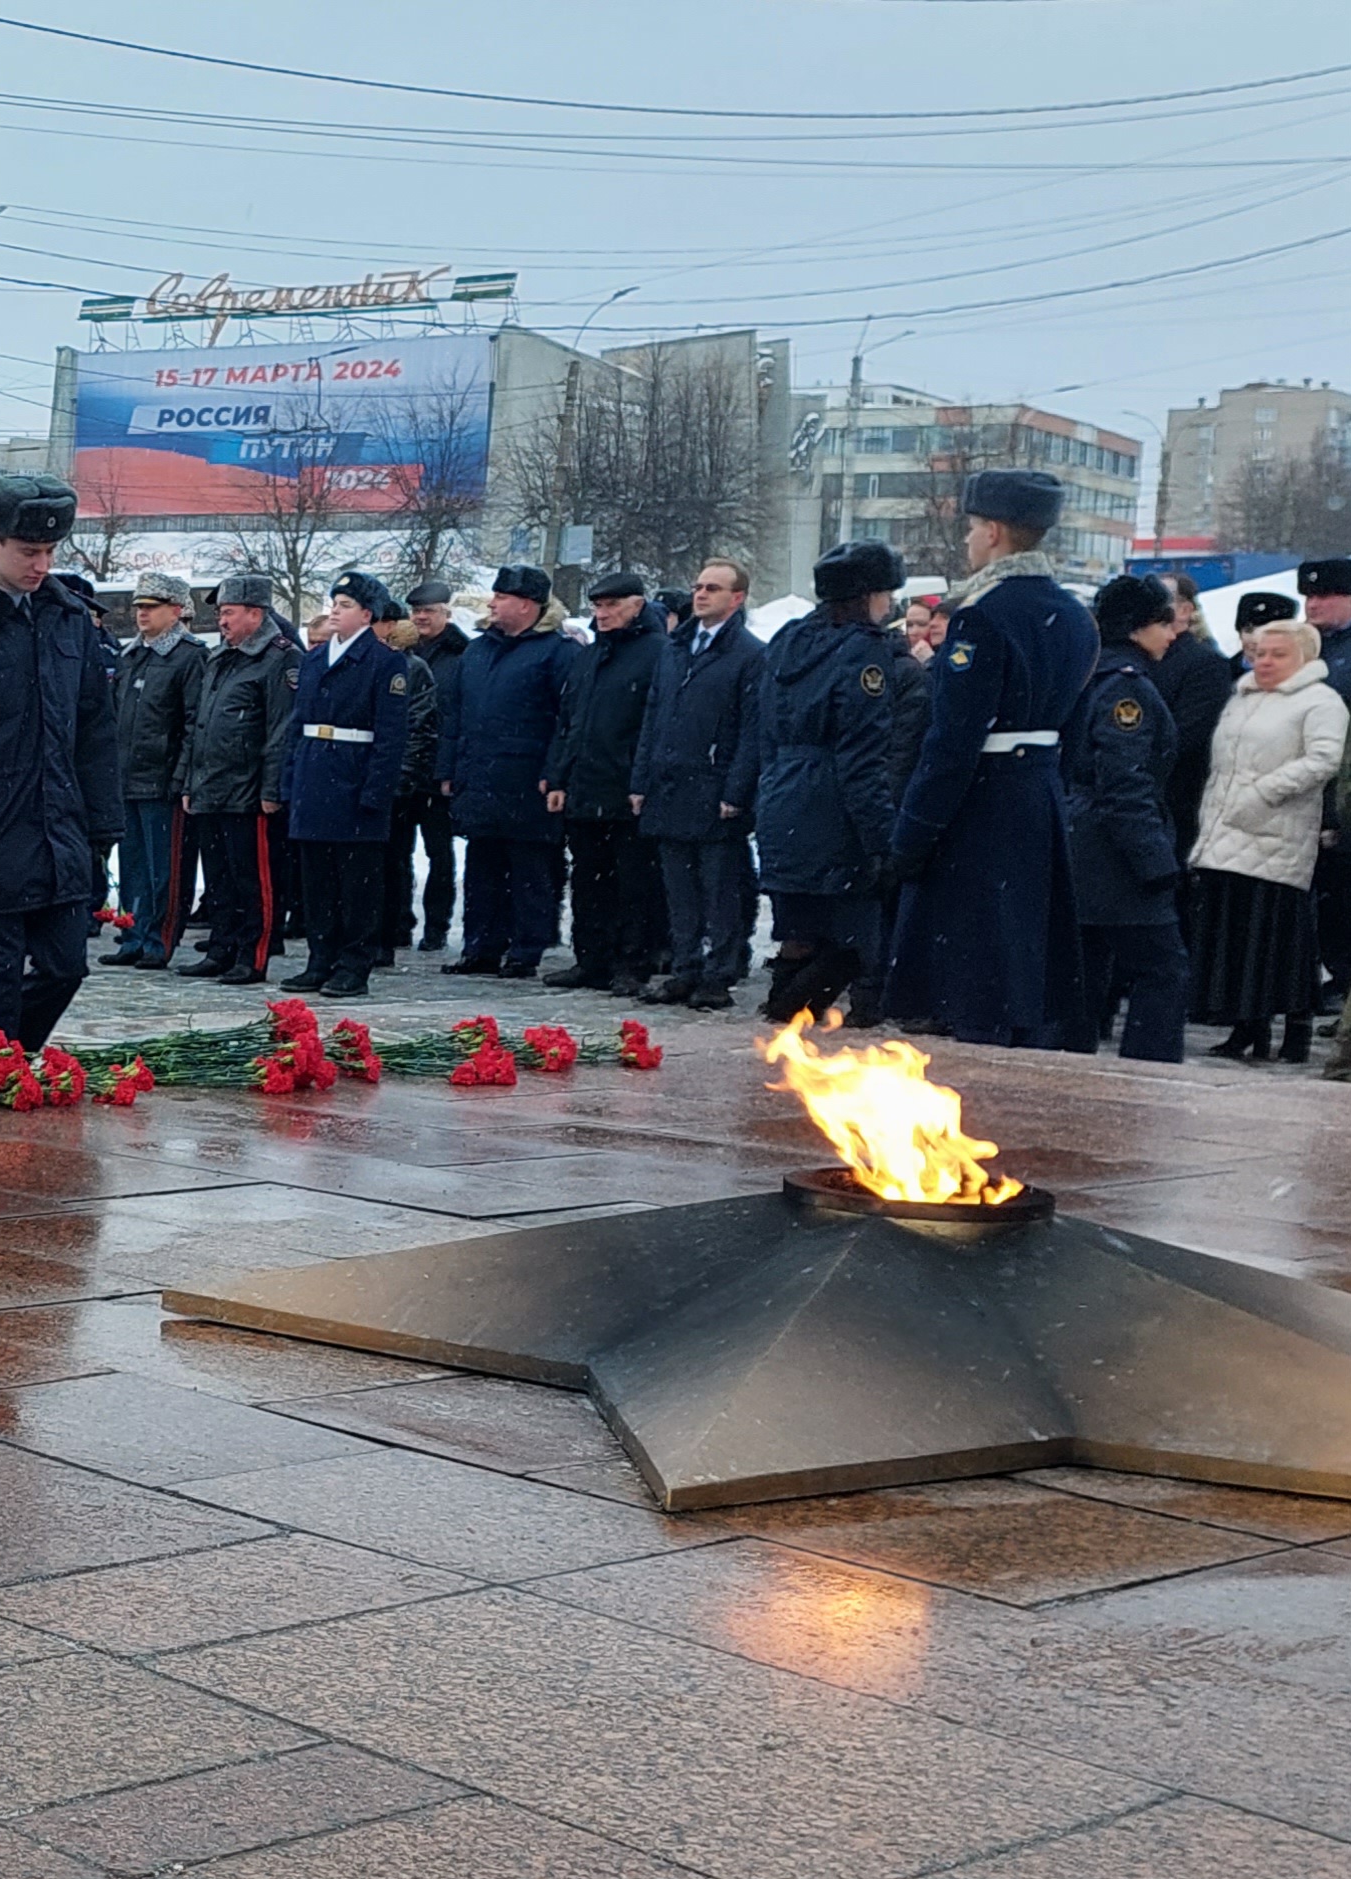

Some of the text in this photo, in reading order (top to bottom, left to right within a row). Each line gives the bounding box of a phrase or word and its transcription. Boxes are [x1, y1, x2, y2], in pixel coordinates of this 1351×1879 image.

[155, 359, 402, 387] 15-17 МАРТА 2024
[157, 404, 272, 427] РОССИЯ
[239, 436, 337, 459] ПУТИН
[323, 469, 392, 491] 2024
